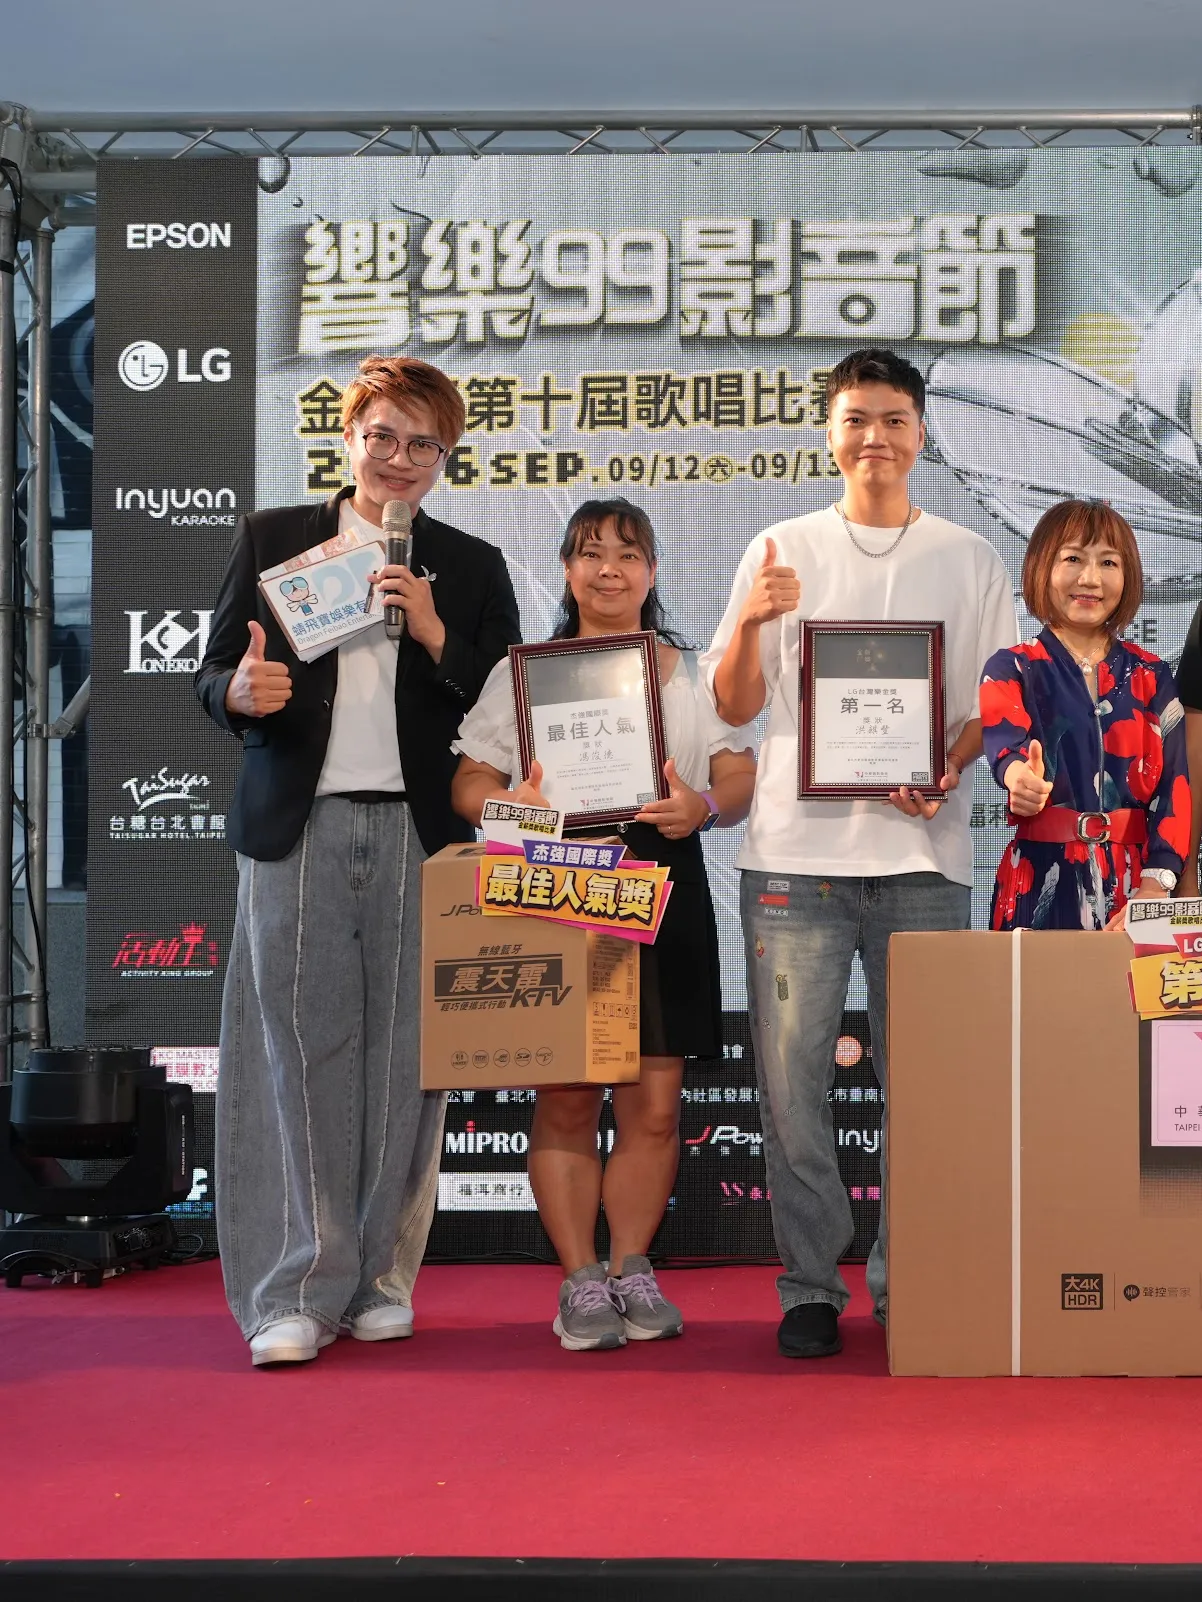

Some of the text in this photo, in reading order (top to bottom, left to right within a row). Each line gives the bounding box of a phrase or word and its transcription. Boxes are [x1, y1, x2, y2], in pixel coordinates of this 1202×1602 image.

[127, 223, 231, 249] EPSON
[297, 214, 1037, 354] 響樂99影音節
[177, 347, 232, 383] LG
[490, 452, 600, 484] SEP.
[171, 515, 236, 526] KARAOKE
[297, 629, 323, 645] Dragon
[323, 620, 349, 635] Feibao
[840, 697, 904, 714] 第一名
[547, 717, 636, 742] 最佳人氣
[109, 815, 227, 830] 台糖台北會館
[484, 802, 558, 826] 響樂99影音節
[532, 844, 613, 868] 杰強國際獎
[485, 864, 654, 922] 最佳人氣獎
[478, 944, 523, 956] 無線藍牙
[449, 962, 548, 993] 震天雷
[441, 1000, 507, 1012] 輕巧便攜式行動
[509, 986, 573, 1008] KTV
[446, 1120, 529, 1154] MIPRO
[1174, 1123, 1201, 1132] TAIPEI
[838, 1128, 882, 1152] Iny
[1064, 1276, 1100, 1292] 大4K
[1068, 1294, 1097, 1306] HDR
